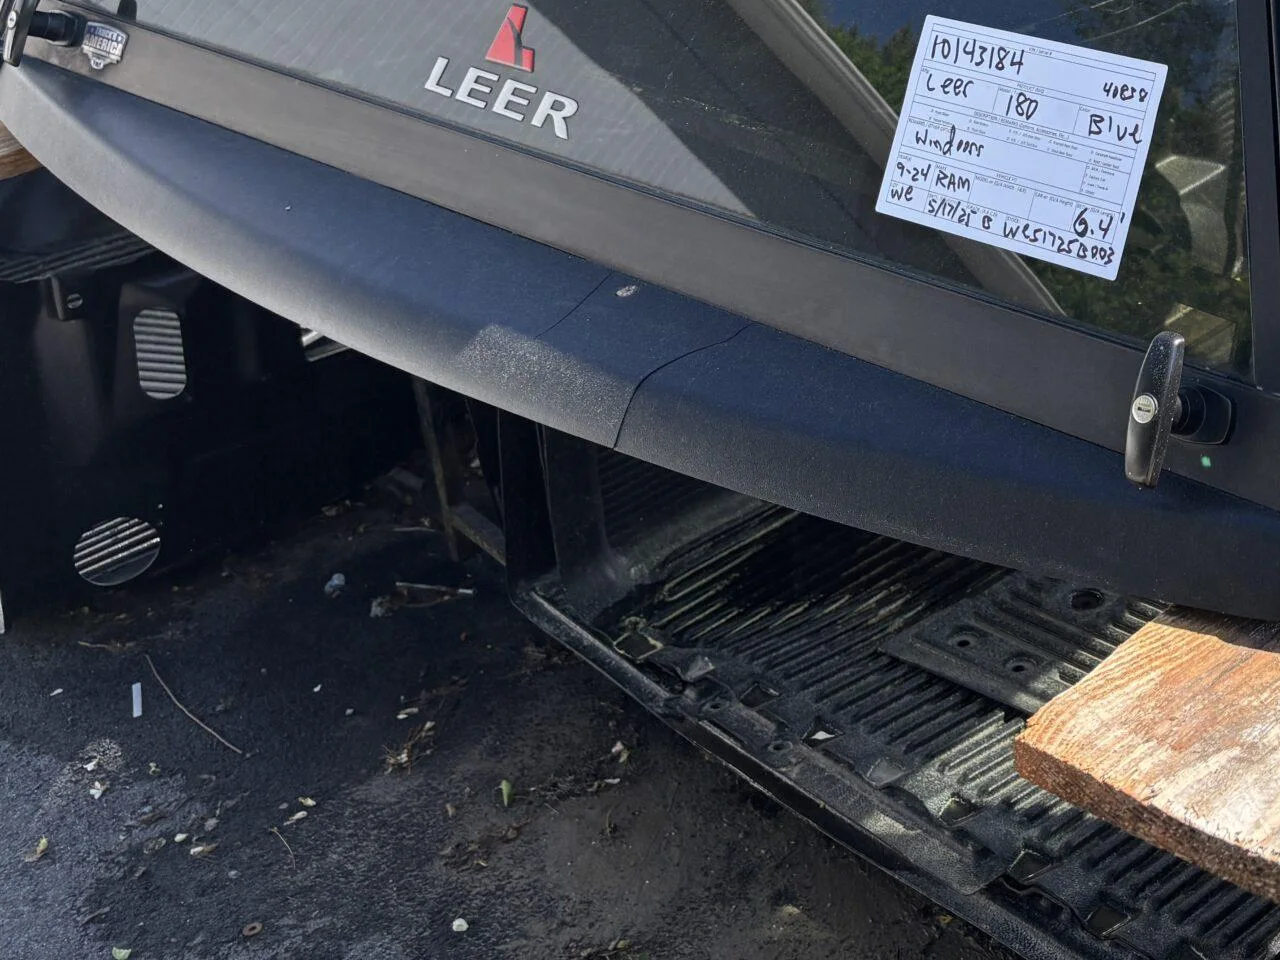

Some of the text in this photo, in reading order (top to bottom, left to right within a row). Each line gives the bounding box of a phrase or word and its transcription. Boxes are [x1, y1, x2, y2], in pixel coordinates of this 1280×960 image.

[81, 32, 124, 56] AMERICA
[931, 34, 1024, 74] 10143184
[424, 55, 579, 140] LEER
[926, 73, 973, 97] Leer
[1005, 91, 1038, 120] 180
[1088, 113, 1141, 144] Blue
[896, 161, 930, 181] 9-24
[935, 169, 969, 191] RAM
